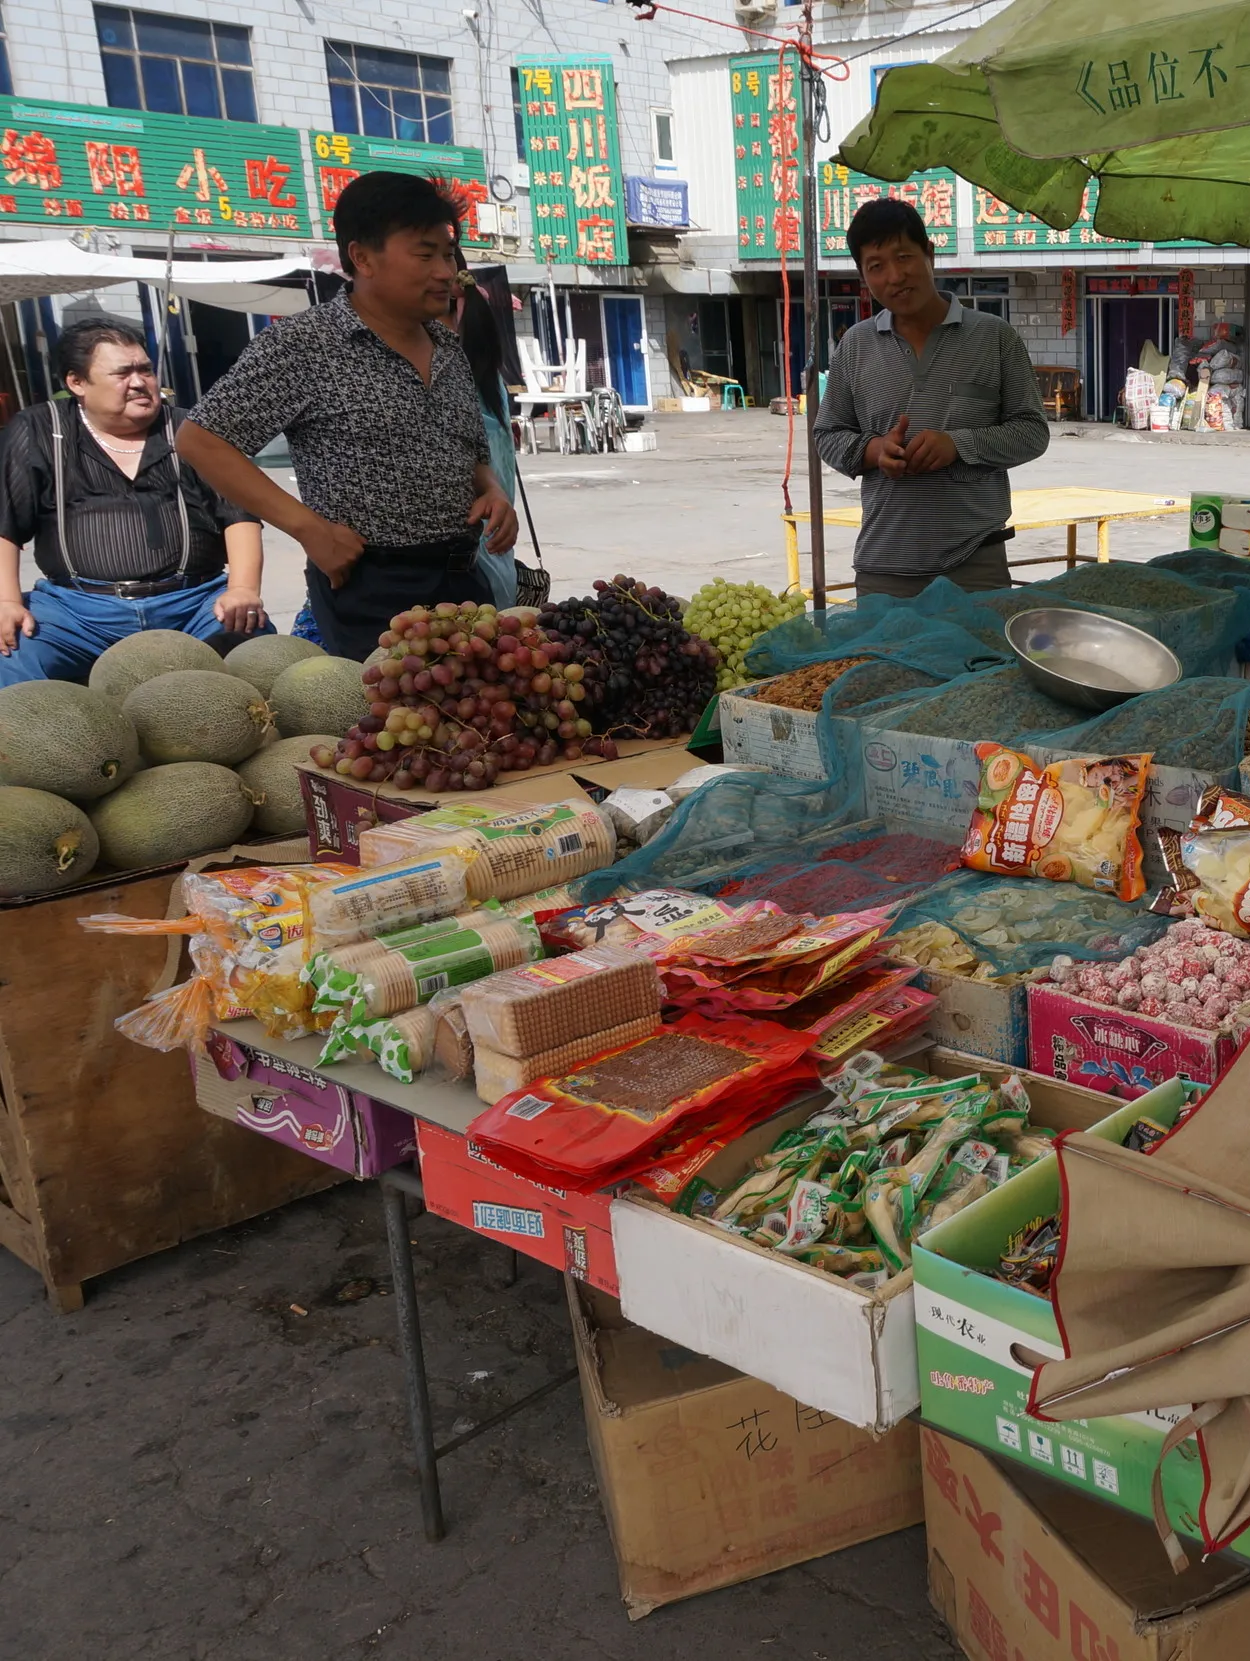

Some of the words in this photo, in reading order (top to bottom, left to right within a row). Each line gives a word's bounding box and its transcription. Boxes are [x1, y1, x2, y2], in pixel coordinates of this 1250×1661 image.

[522, 69, 553, 95] 7号
[732, 71, 760, 96] 8号
[315, 134, 352, 165] 6号
[530, 136, 560, 151] 炒面
[1, 128, 297, 208] 绵阳小吃
[562, 69, 615, 262] 四川饭店
[823, 164, 850, 187] 9号
[534, 172, 564, 186] 米饭
[43, 198, 84, 217] 炒面
[218, 196, 234, 221] 5
[537, 204, 567, 219] 炒菜
[1046, 228, 1070, 245] 米饭
[929, 1305, 987, 1347] 现代农业
[930, 1370, 994, 1395] 吐鲁番特产
[726, 1409, 779, 1461] 花
